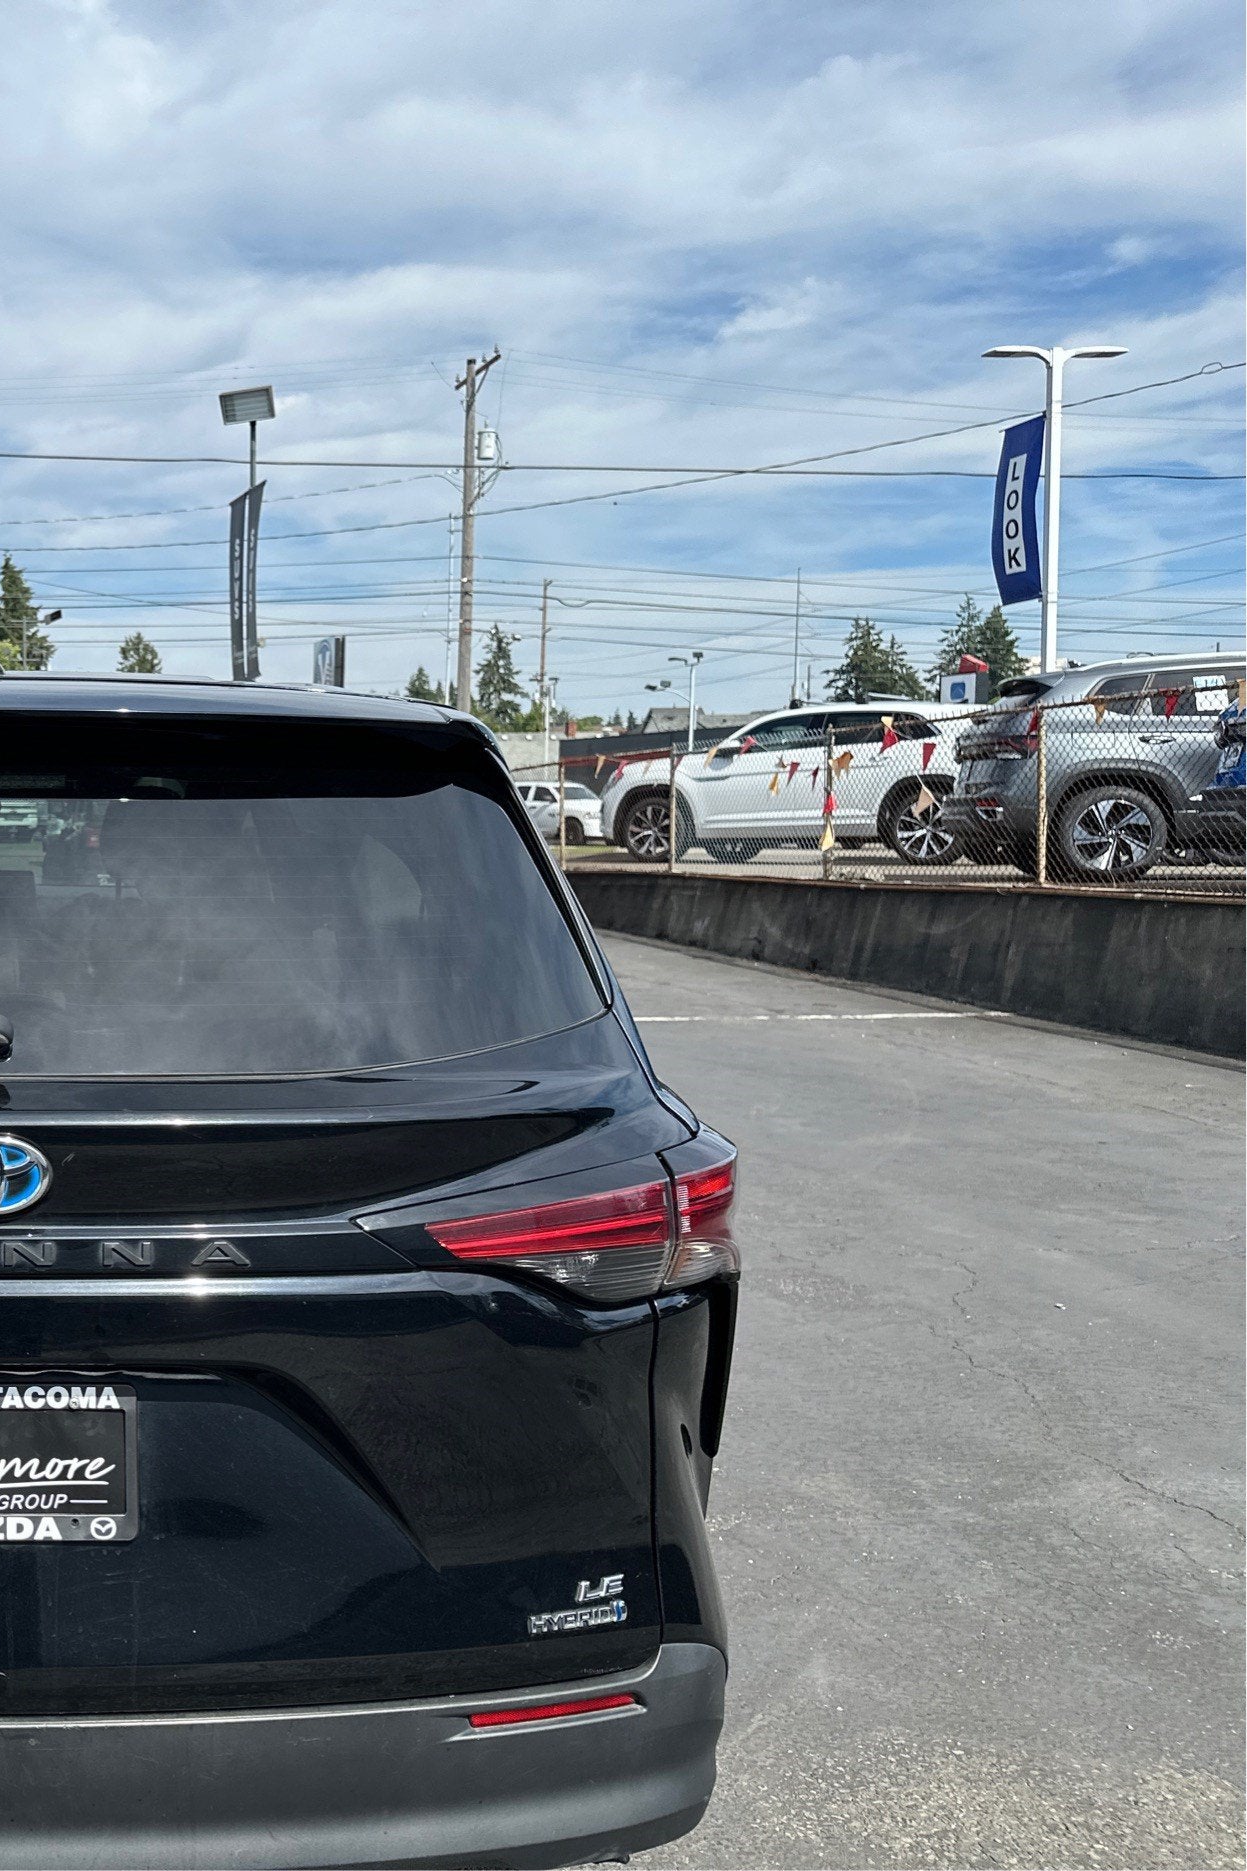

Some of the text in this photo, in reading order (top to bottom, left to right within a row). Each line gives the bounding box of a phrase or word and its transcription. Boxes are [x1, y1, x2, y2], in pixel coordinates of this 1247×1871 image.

[1005, 461, 1022, 569] LOOK
[574, 1573, 625, 1604] LE
[527, 1603, 613, 1635] HYBRID
